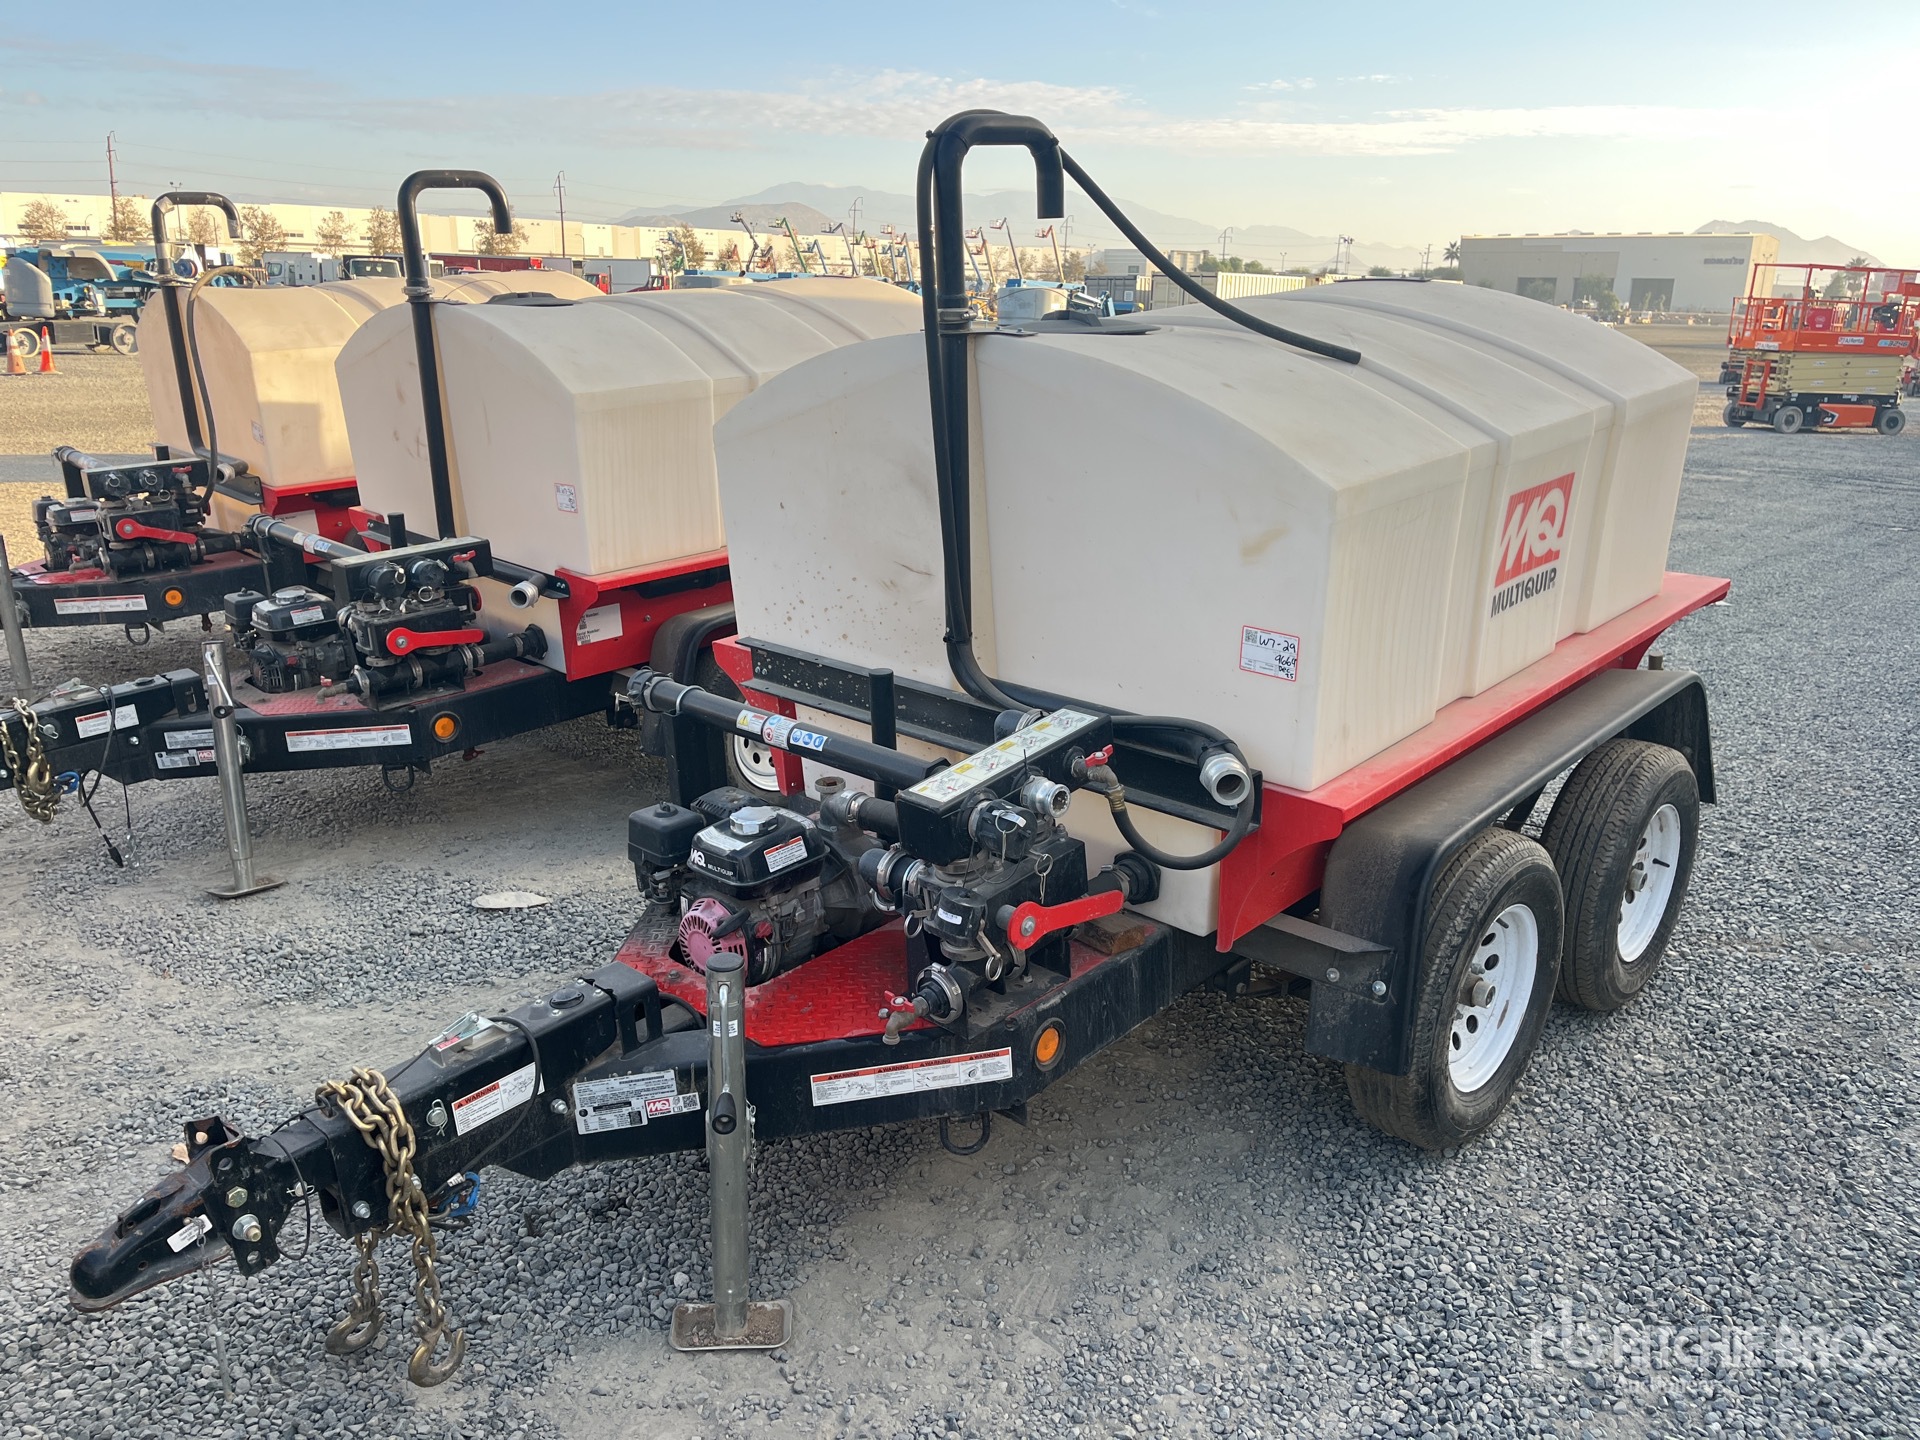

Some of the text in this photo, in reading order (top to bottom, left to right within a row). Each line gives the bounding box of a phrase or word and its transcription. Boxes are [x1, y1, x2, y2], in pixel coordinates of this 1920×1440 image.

[1500, 486, 1566, 572] MQ
[1490, 567, 1557, 618] MULTIQUIP
[707, 863, 734, 877] MULTIQUIP
[465, 1083, 497, 1104] WARNING
[648, 1099, 671, 1113] MQ
